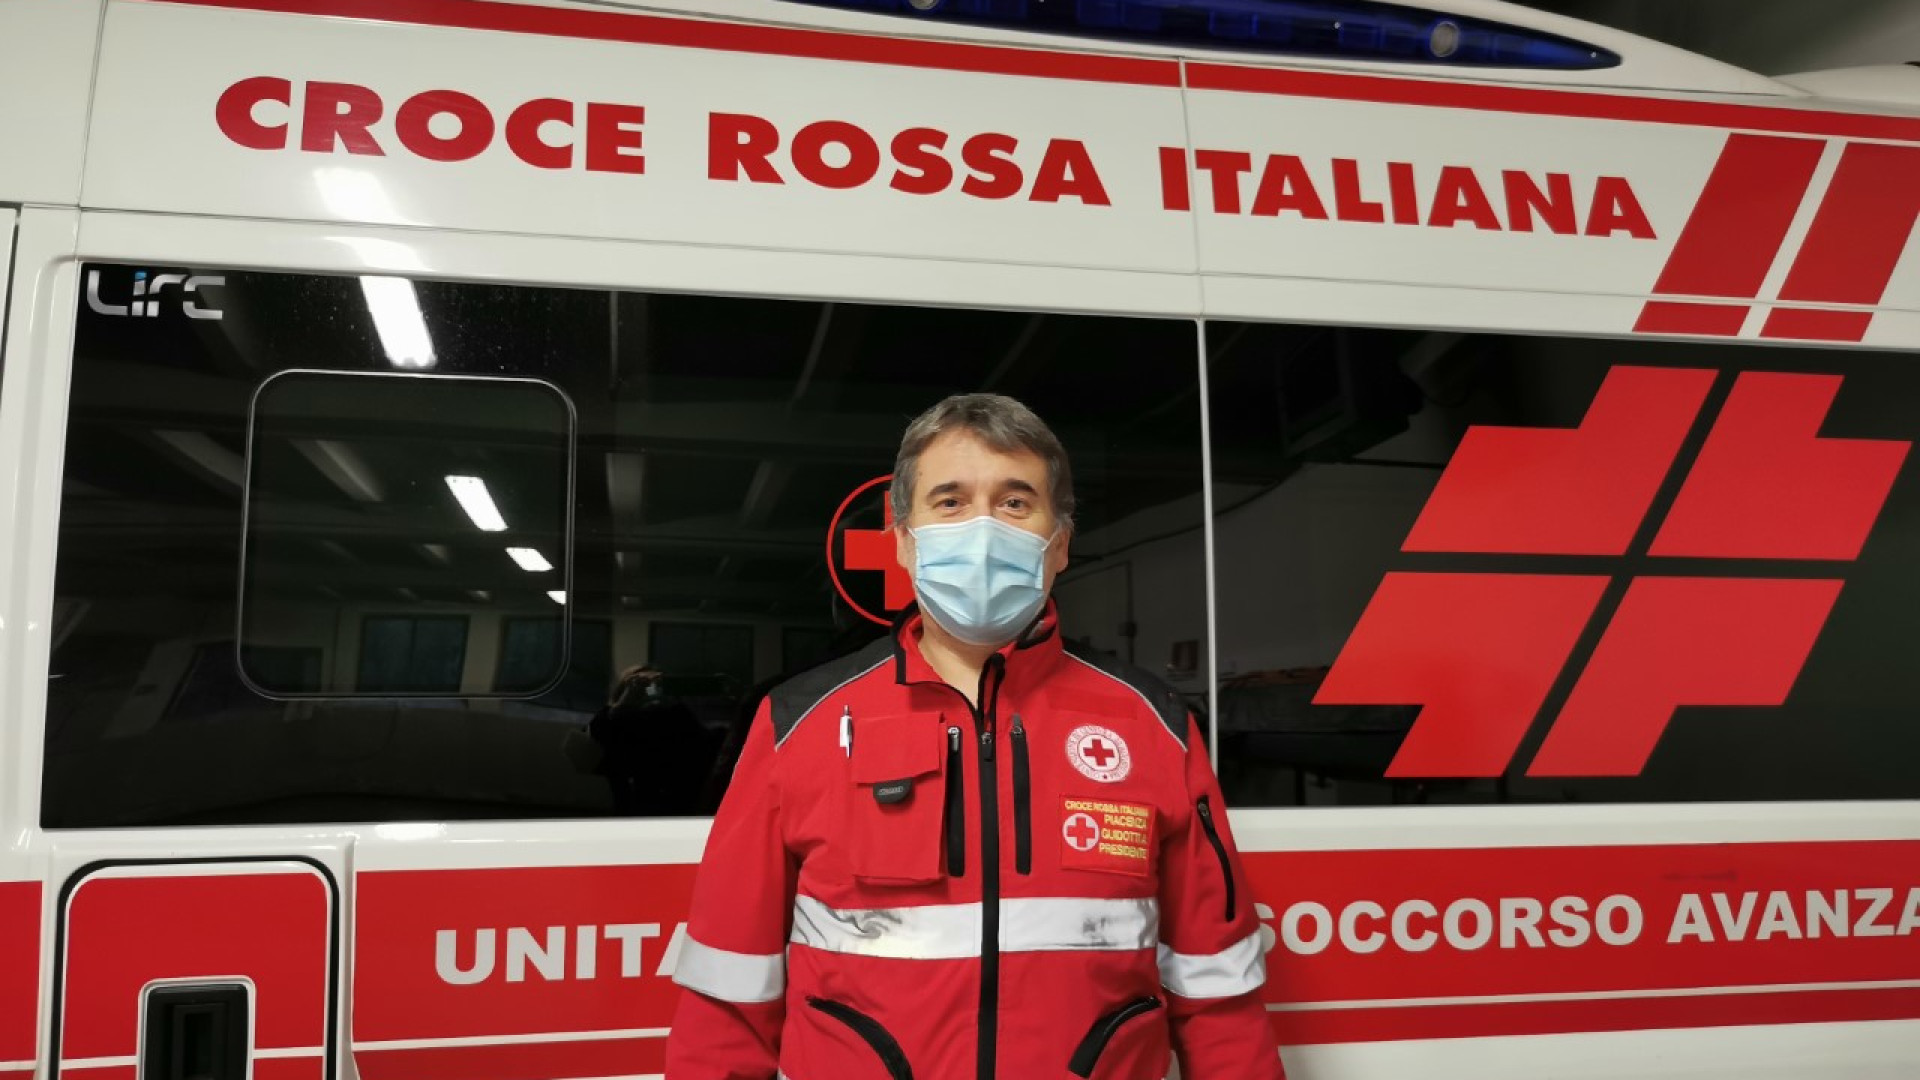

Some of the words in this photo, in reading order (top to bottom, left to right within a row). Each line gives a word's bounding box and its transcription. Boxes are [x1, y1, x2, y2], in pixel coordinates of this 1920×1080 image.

[216, 76, 646, 175] CROCE
[708, 112, 1111, 207] ROSSA
[1159, 146, 1657, 240] ITALIANA
[1065, 800, 1093, 811] CROCE
